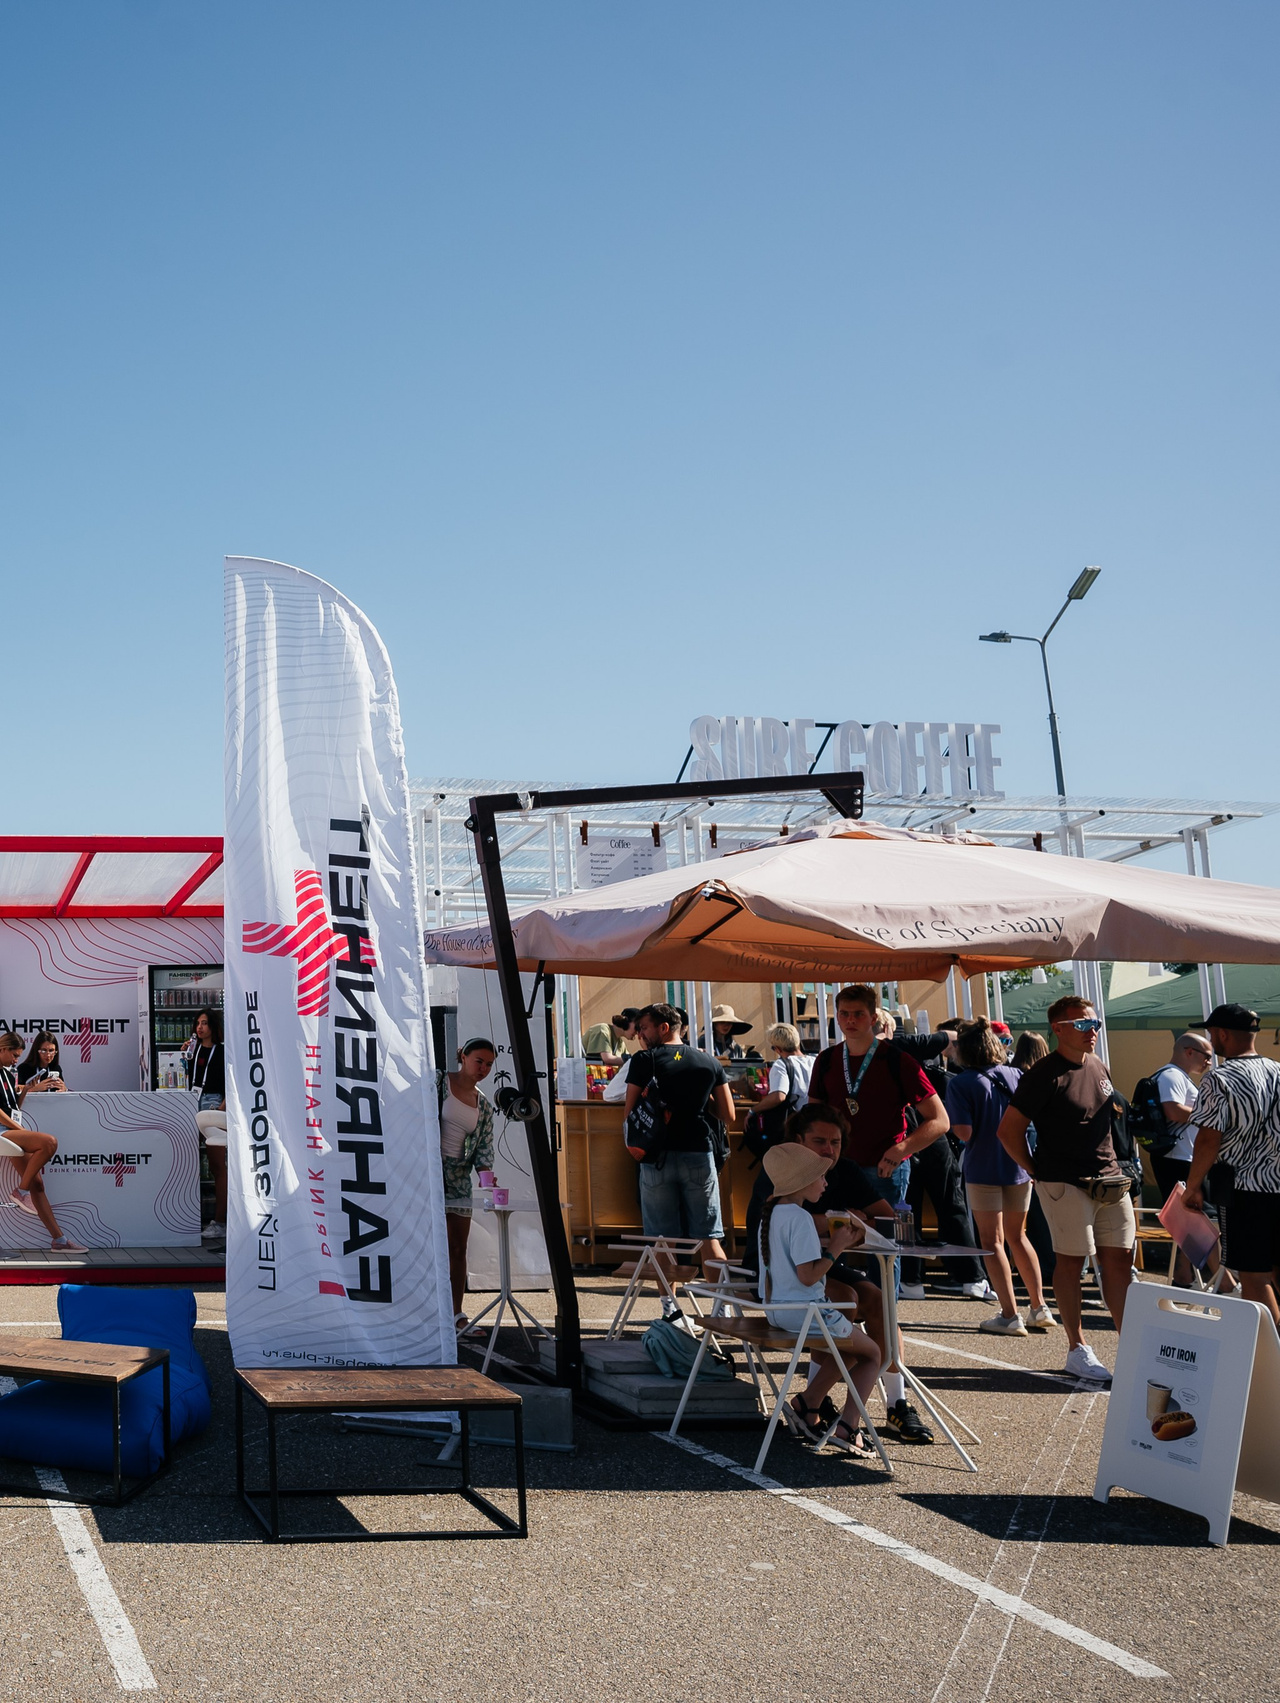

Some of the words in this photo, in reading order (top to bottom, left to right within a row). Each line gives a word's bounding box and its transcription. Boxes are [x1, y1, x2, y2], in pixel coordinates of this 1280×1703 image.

[689, 714, 816, 782] SURF
[833, 719, 1006, 800] COFFEE
[609, 838, 631, 849] Coffee
[899, 919, 927, 941] of
[930, 915, 1065, 942] Specialty
[424, 934, 440, 951] The
[442, 933, 466, 951] House
[467, 934, 481, 951] of
[1160, 1344, 1176, 1359] HOT
[1176, 1348, 1197, 1363] IRON
